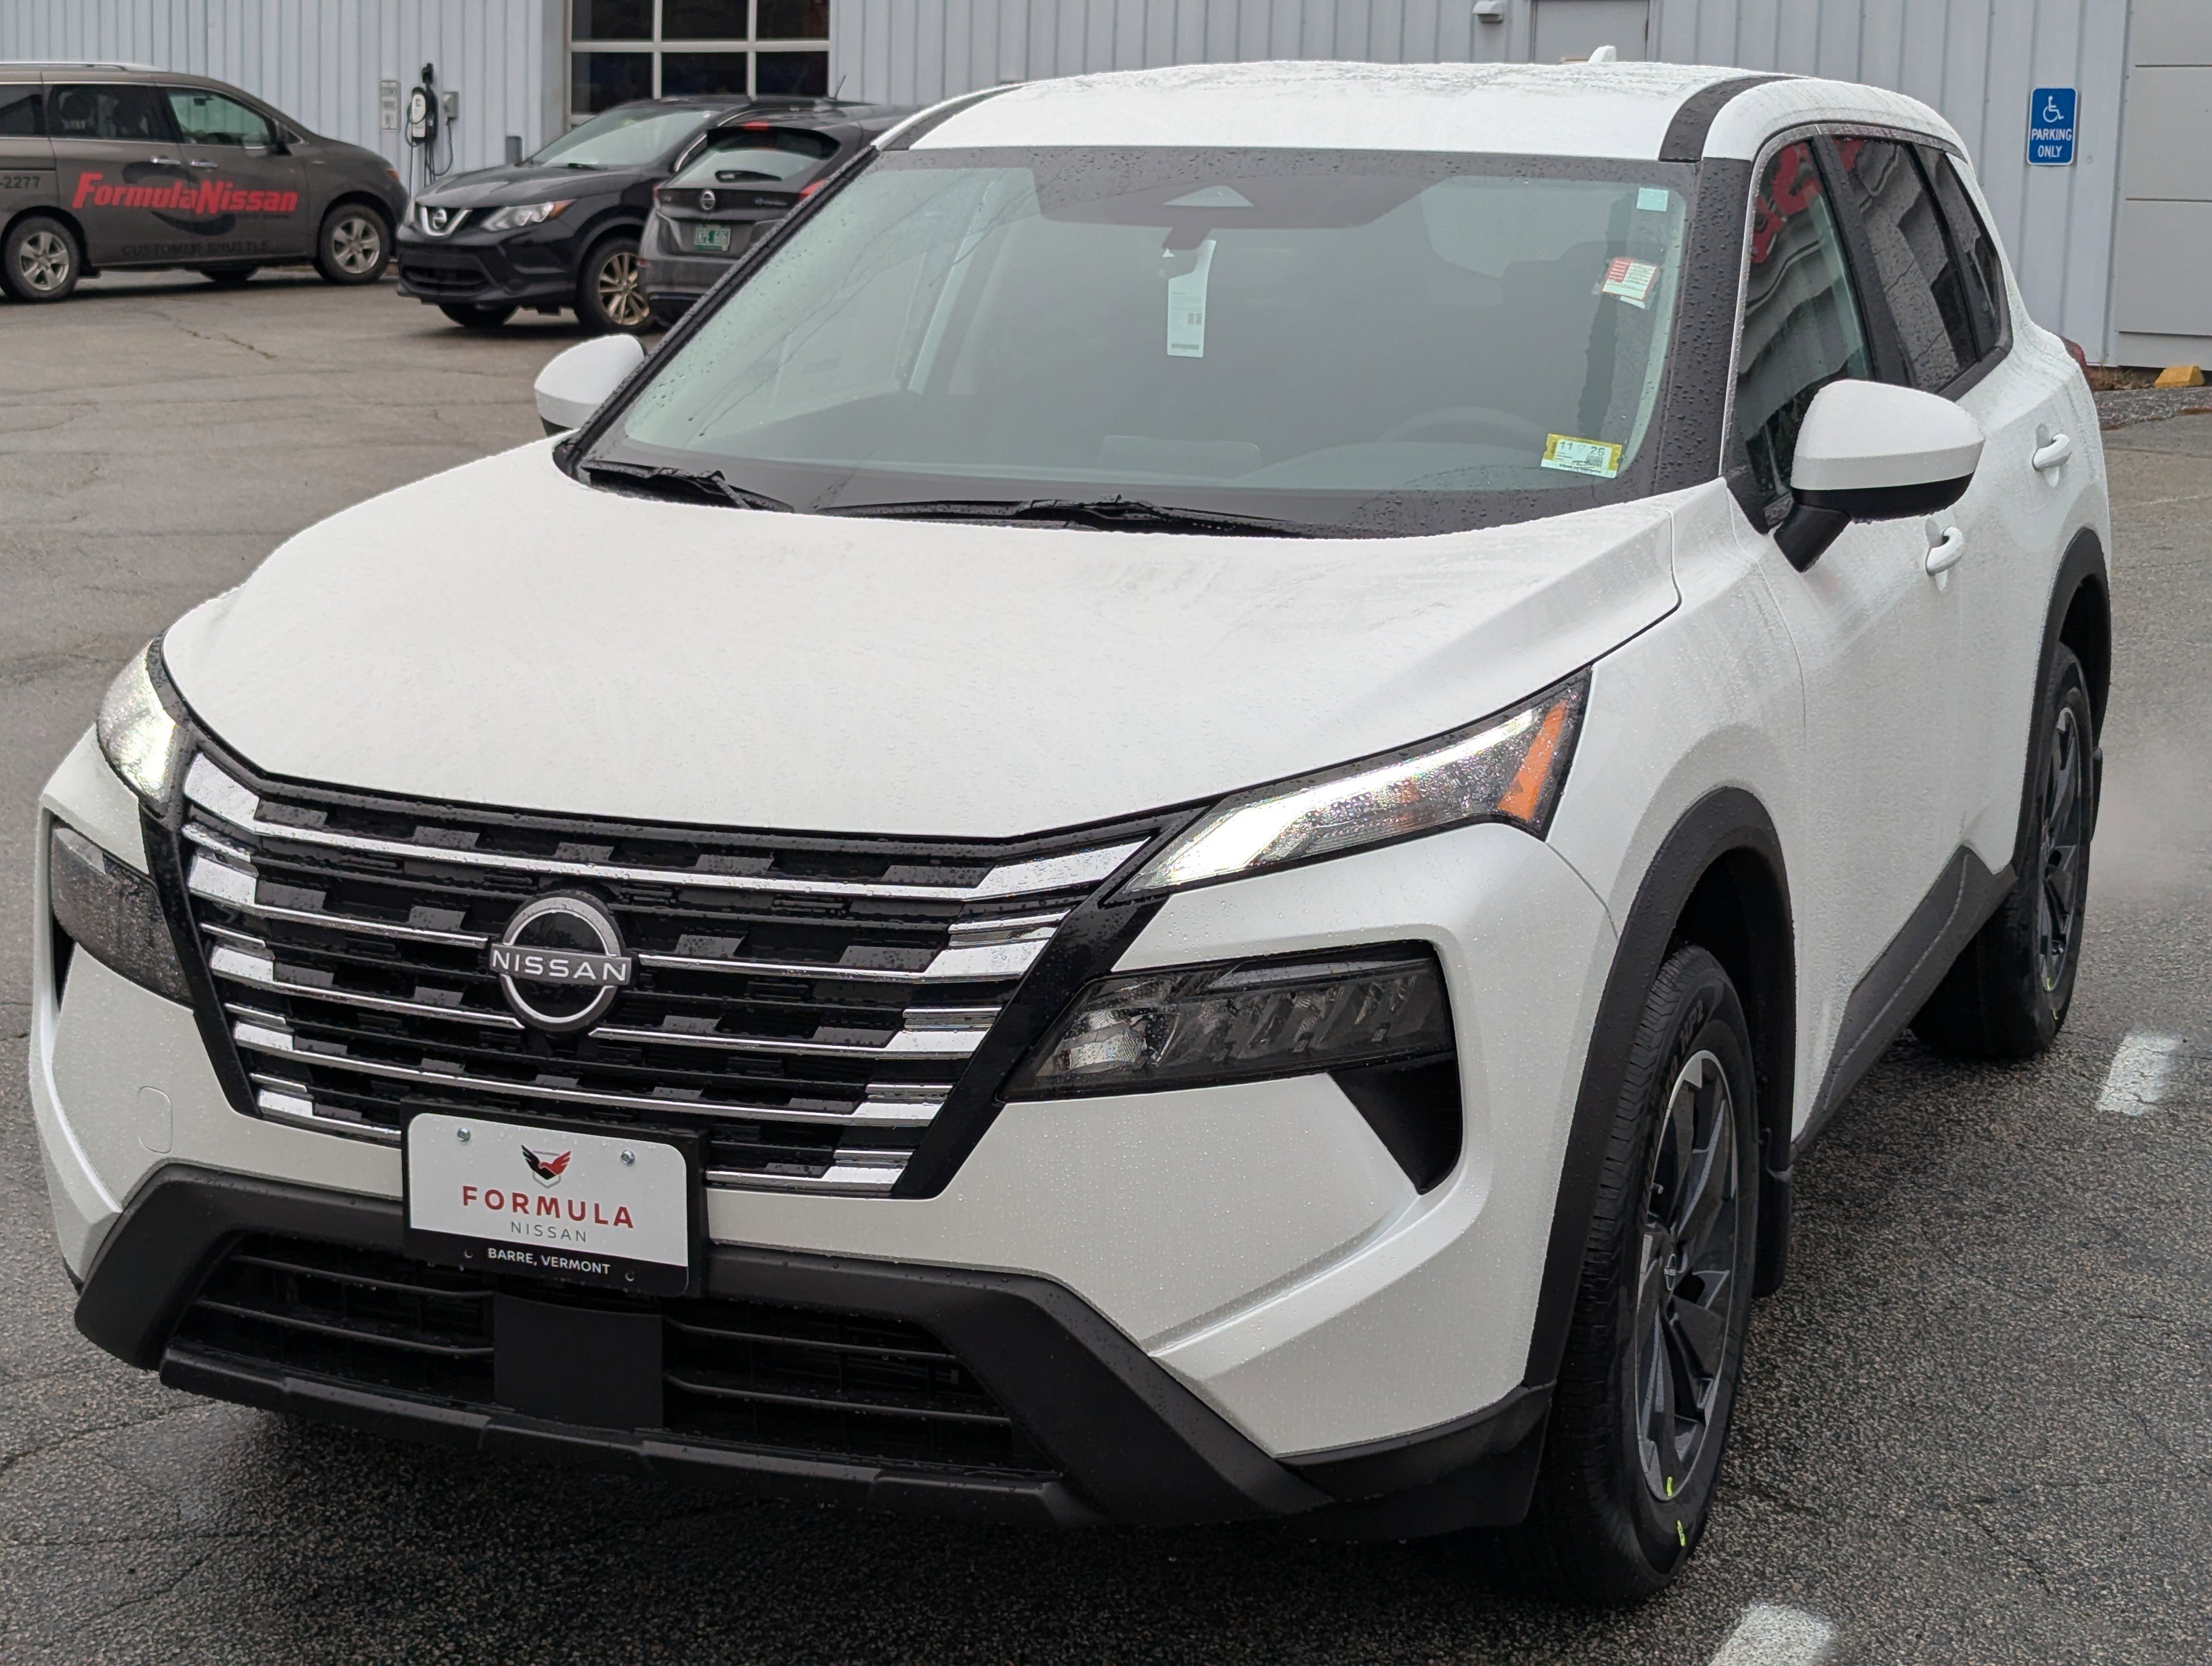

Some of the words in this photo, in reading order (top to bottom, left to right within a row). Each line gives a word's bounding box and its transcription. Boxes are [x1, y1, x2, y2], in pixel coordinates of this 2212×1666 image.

[2031, 128, 2072, 141] PARKING
[2037, 145, 2062, 158] ONLY
[493, 950, 626, 981] NISSAN
[462, 1185, 634, 1229] FORMULA
[511, 1221, 587, 1242] NISSAN
[488, 1248, 538, 1266] BARRE,
[541, 1255, 610, 1275] VERMONT
